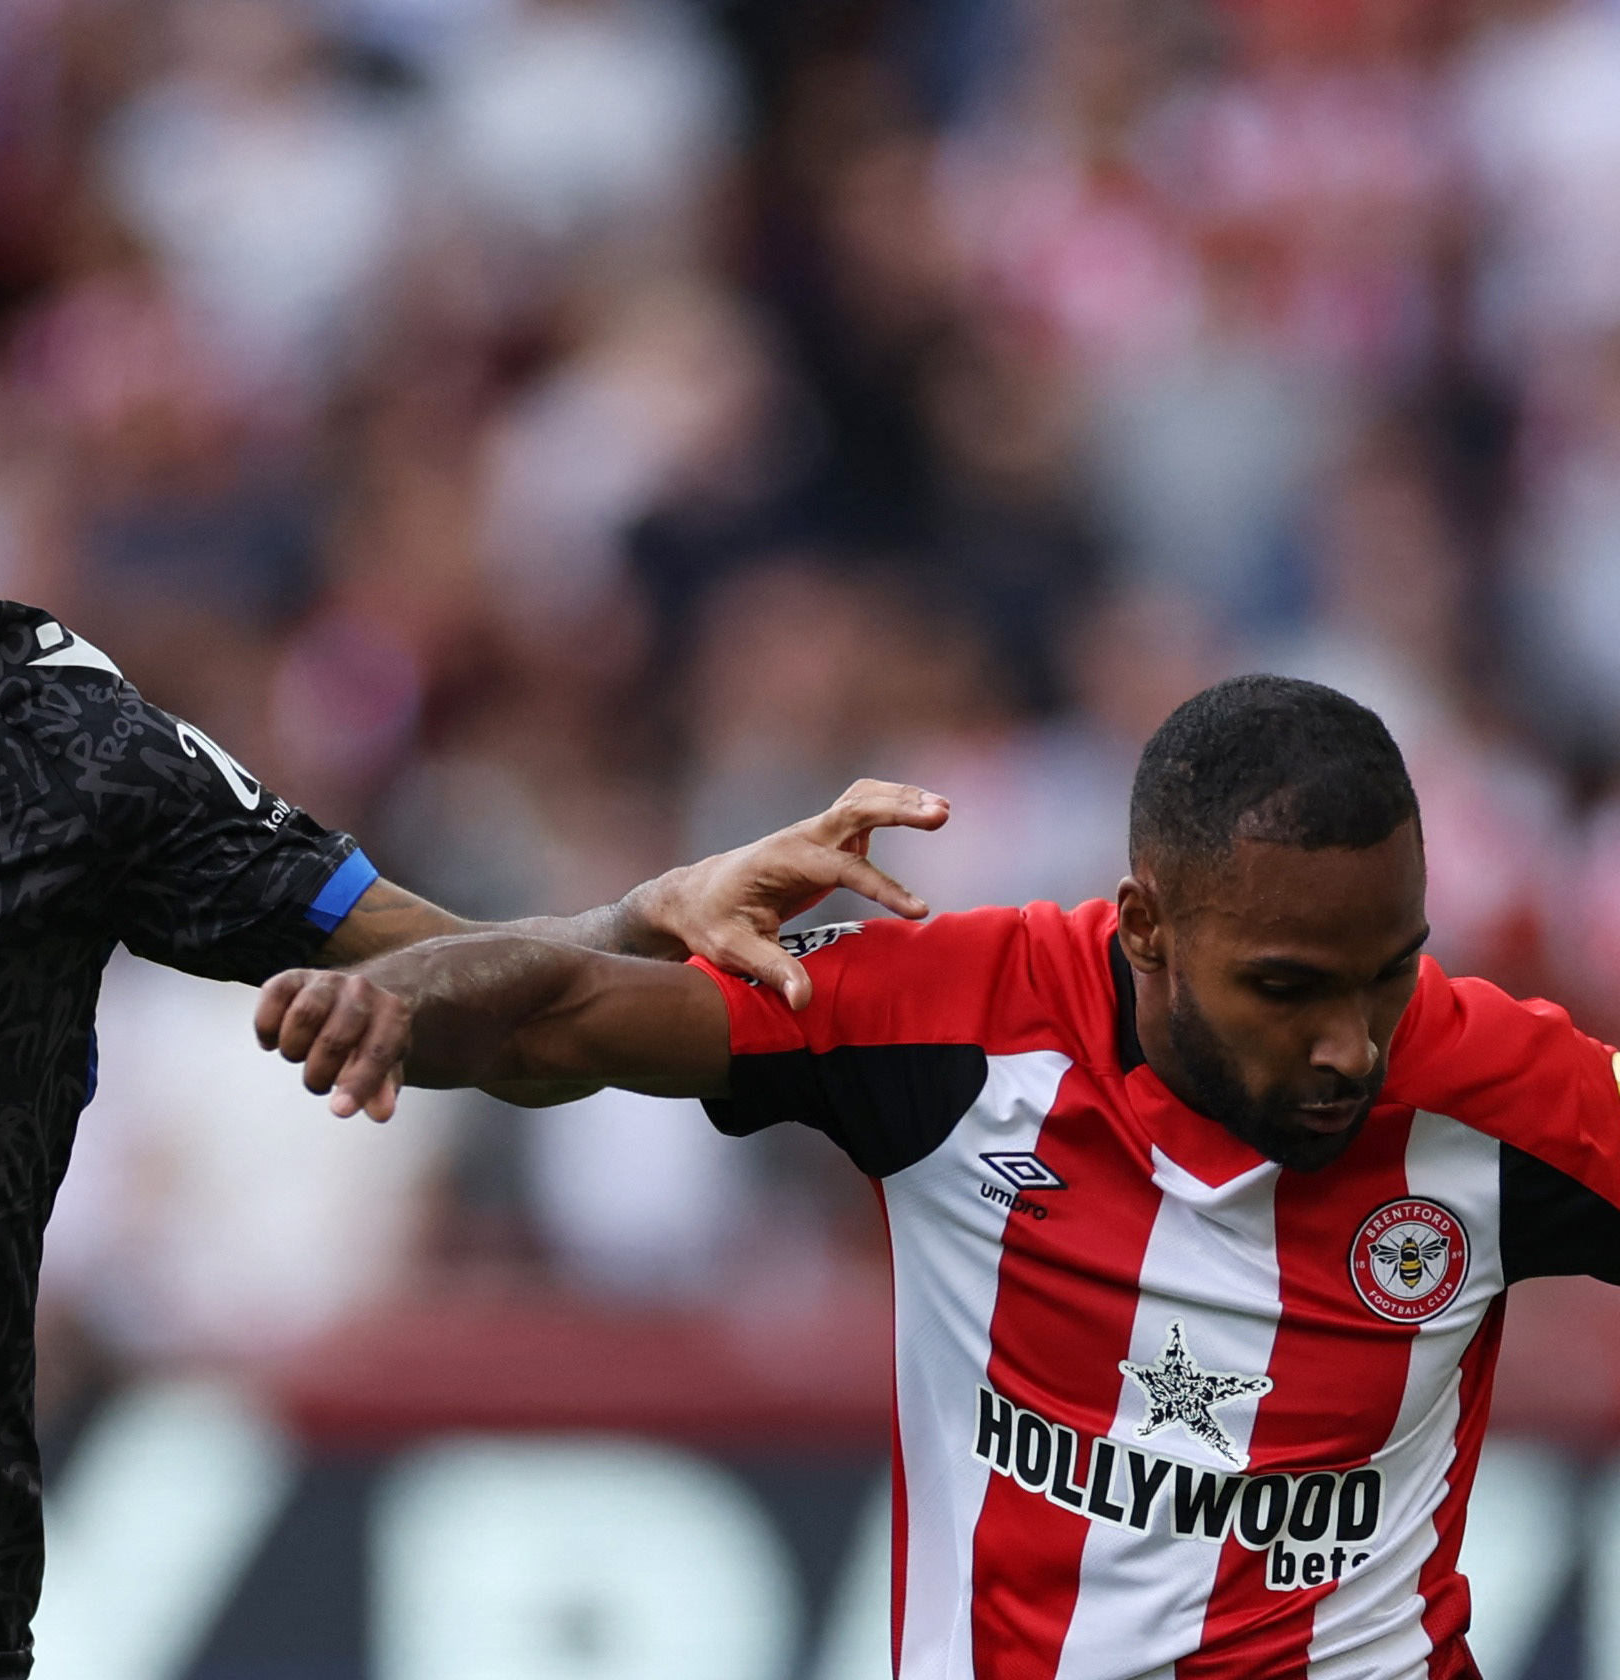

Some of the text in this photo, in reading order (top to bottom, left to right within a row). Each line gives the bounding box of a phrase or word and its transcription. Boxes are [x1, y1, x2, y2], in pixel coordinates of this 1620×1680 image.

[980, 1182, 1048, 1220] umbro
[1365, 1206, 1451, 1239] BRENTFORD
[1369, 1282, 1453, 1315] FOOTBALL CLUB
[976, 1388, 1381, 1546] HOLLYWOOD
